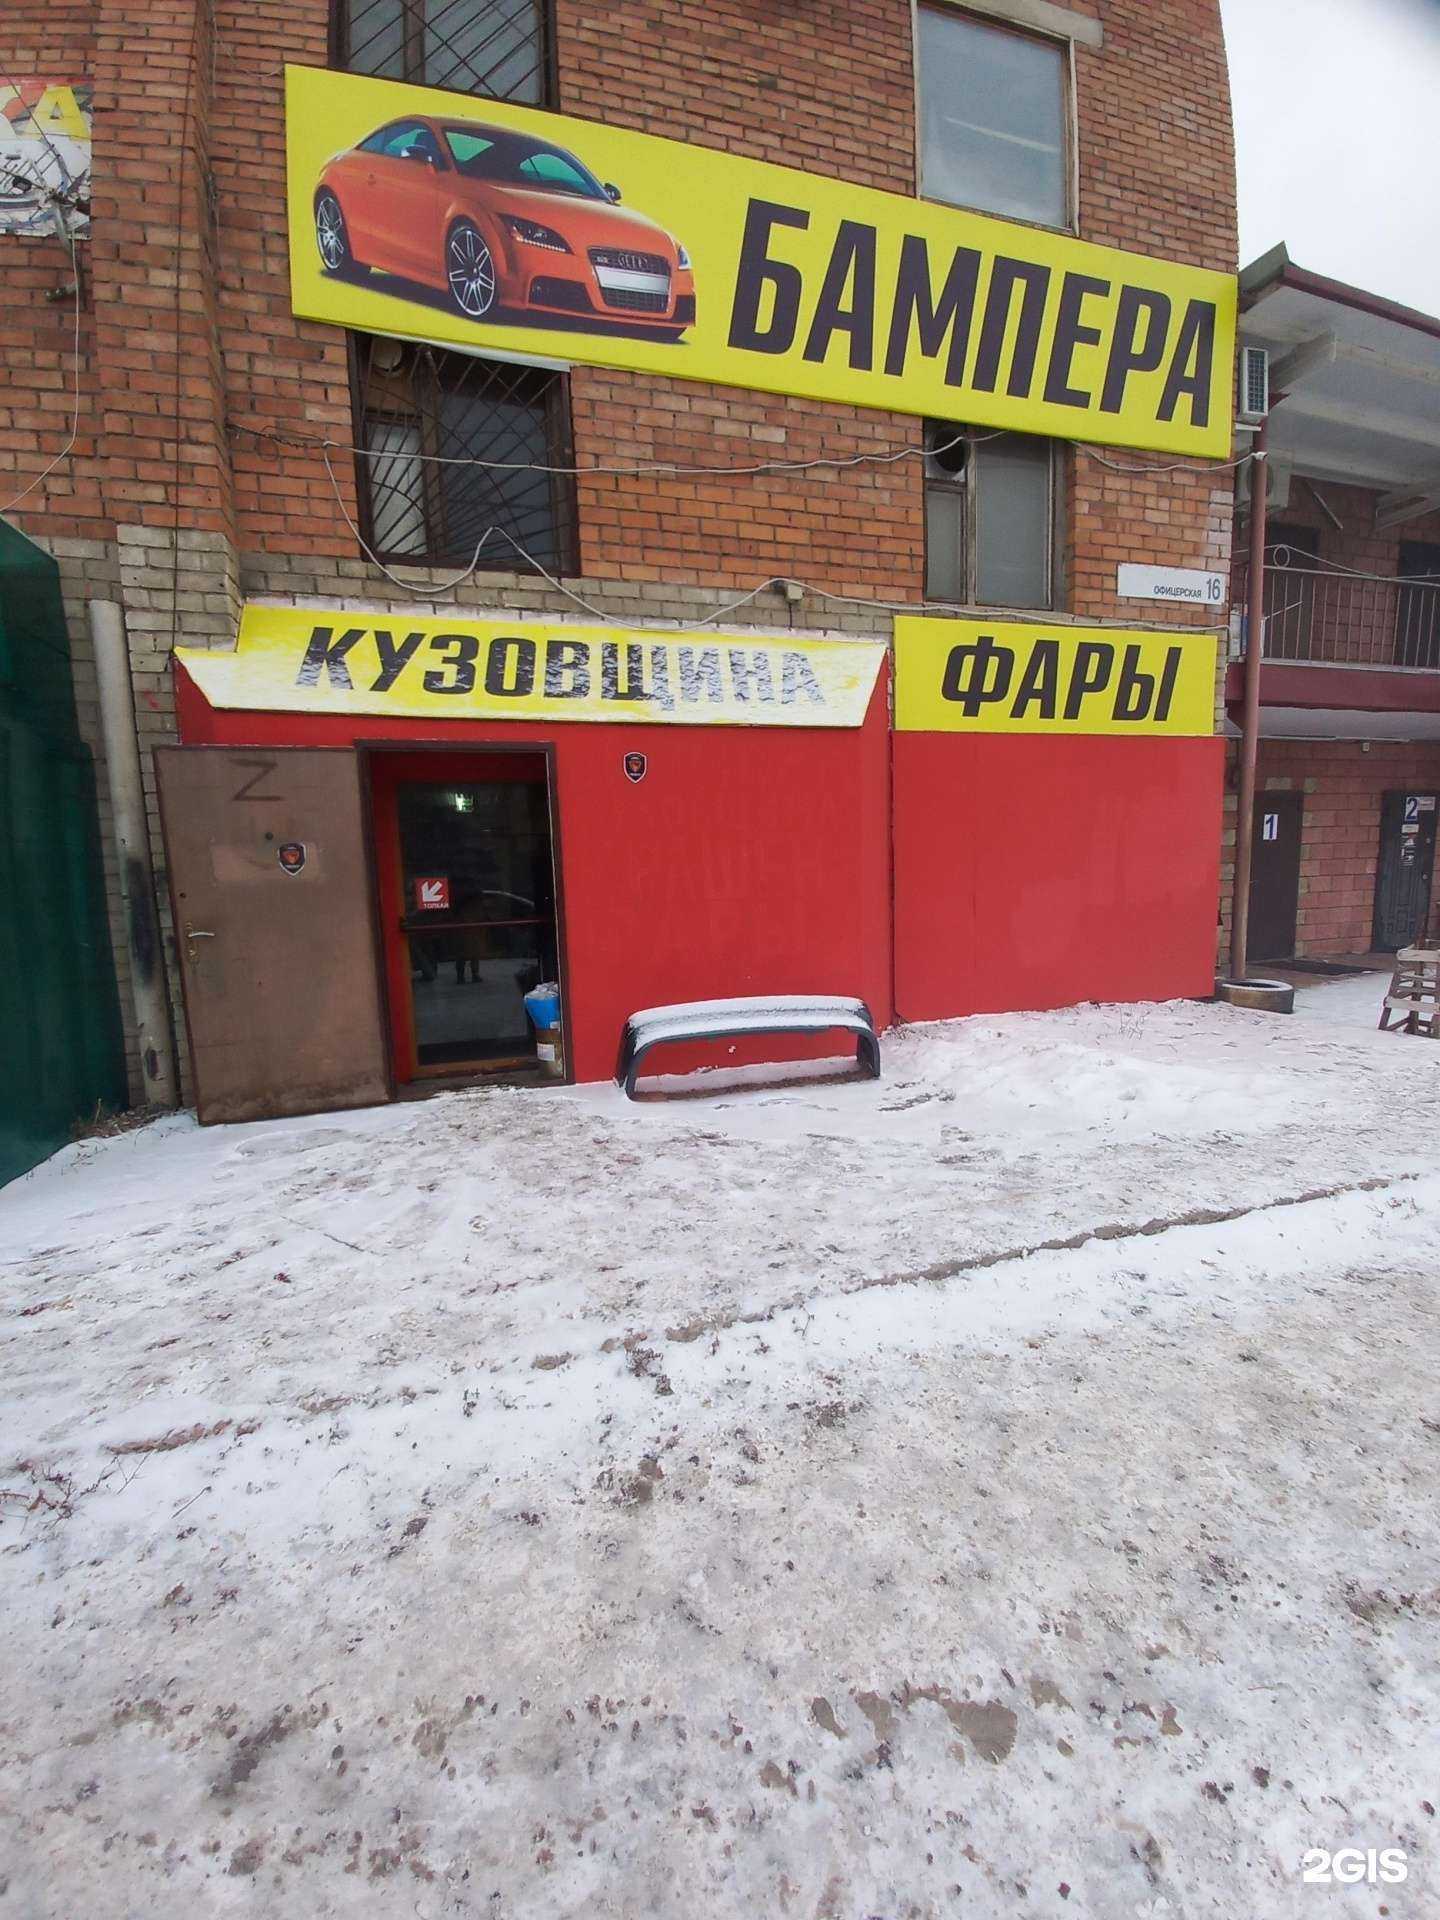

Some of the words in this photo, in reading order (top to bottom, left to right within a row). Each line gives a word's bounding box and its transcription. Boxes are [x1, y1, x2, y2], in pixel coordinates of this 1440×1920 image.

[727, 197, 1216, 428] БАМПЕРА
[1153, 585, 1202, 598] ОФИЦЕРСКАЯ
[1206, 578, 1221, 601] 16
[295, 626, 824, 711] КУЗОВЩИНА
[941, 636, 1182, 721] ФАРЫ
[1265, 815, 1275, 840] 1
[1406, 797, 1418, 819] 2
